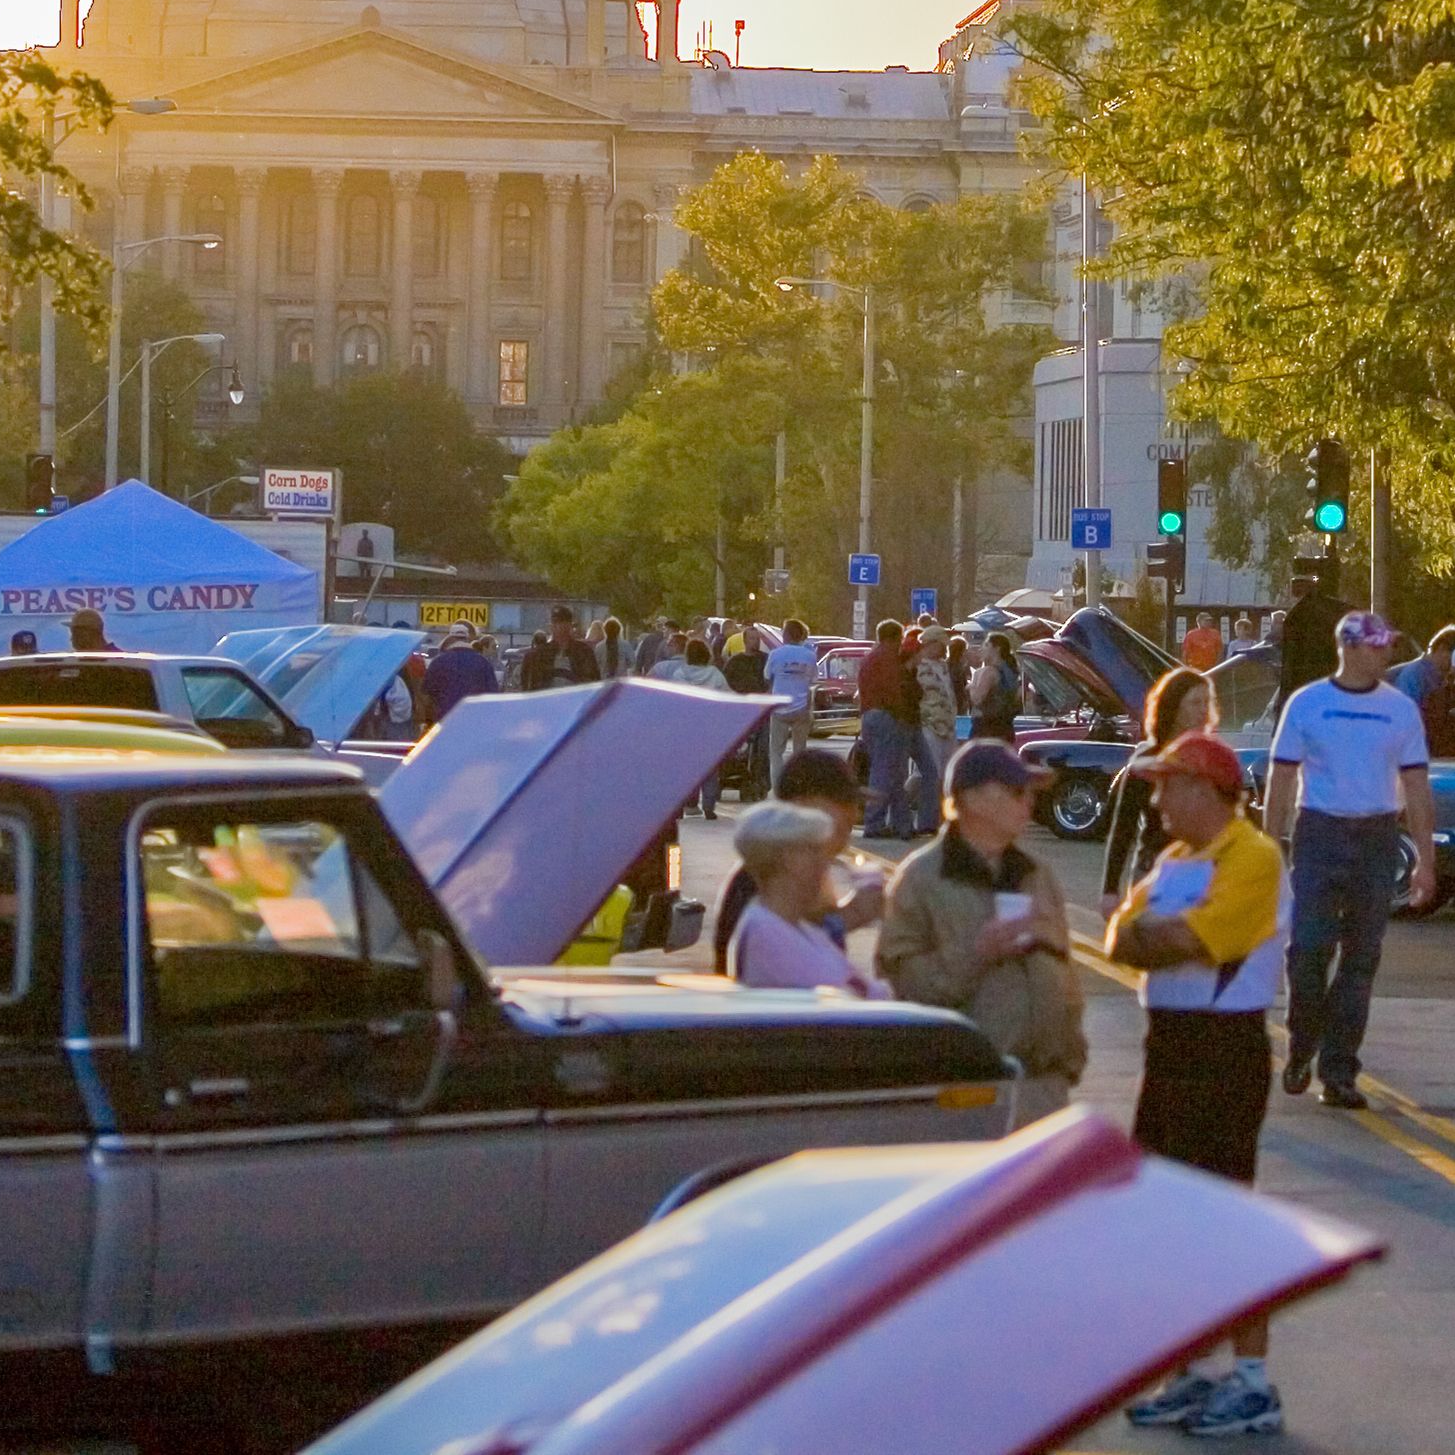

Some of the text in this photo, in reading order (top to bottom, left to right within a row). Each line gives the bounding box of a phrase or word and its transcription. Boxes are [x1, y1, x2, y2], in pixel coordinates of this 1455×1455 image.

[268, 473, 329, 492] Corn Dogs
[268, 492, 328, 507] Cold Drinks
[1091, 513, 1109, 521] STOP
[1085, 525, 1098, 544] B
[860, 567, 868, 580] E
[1, 583, 260, 614] PEASE'S CANDY
